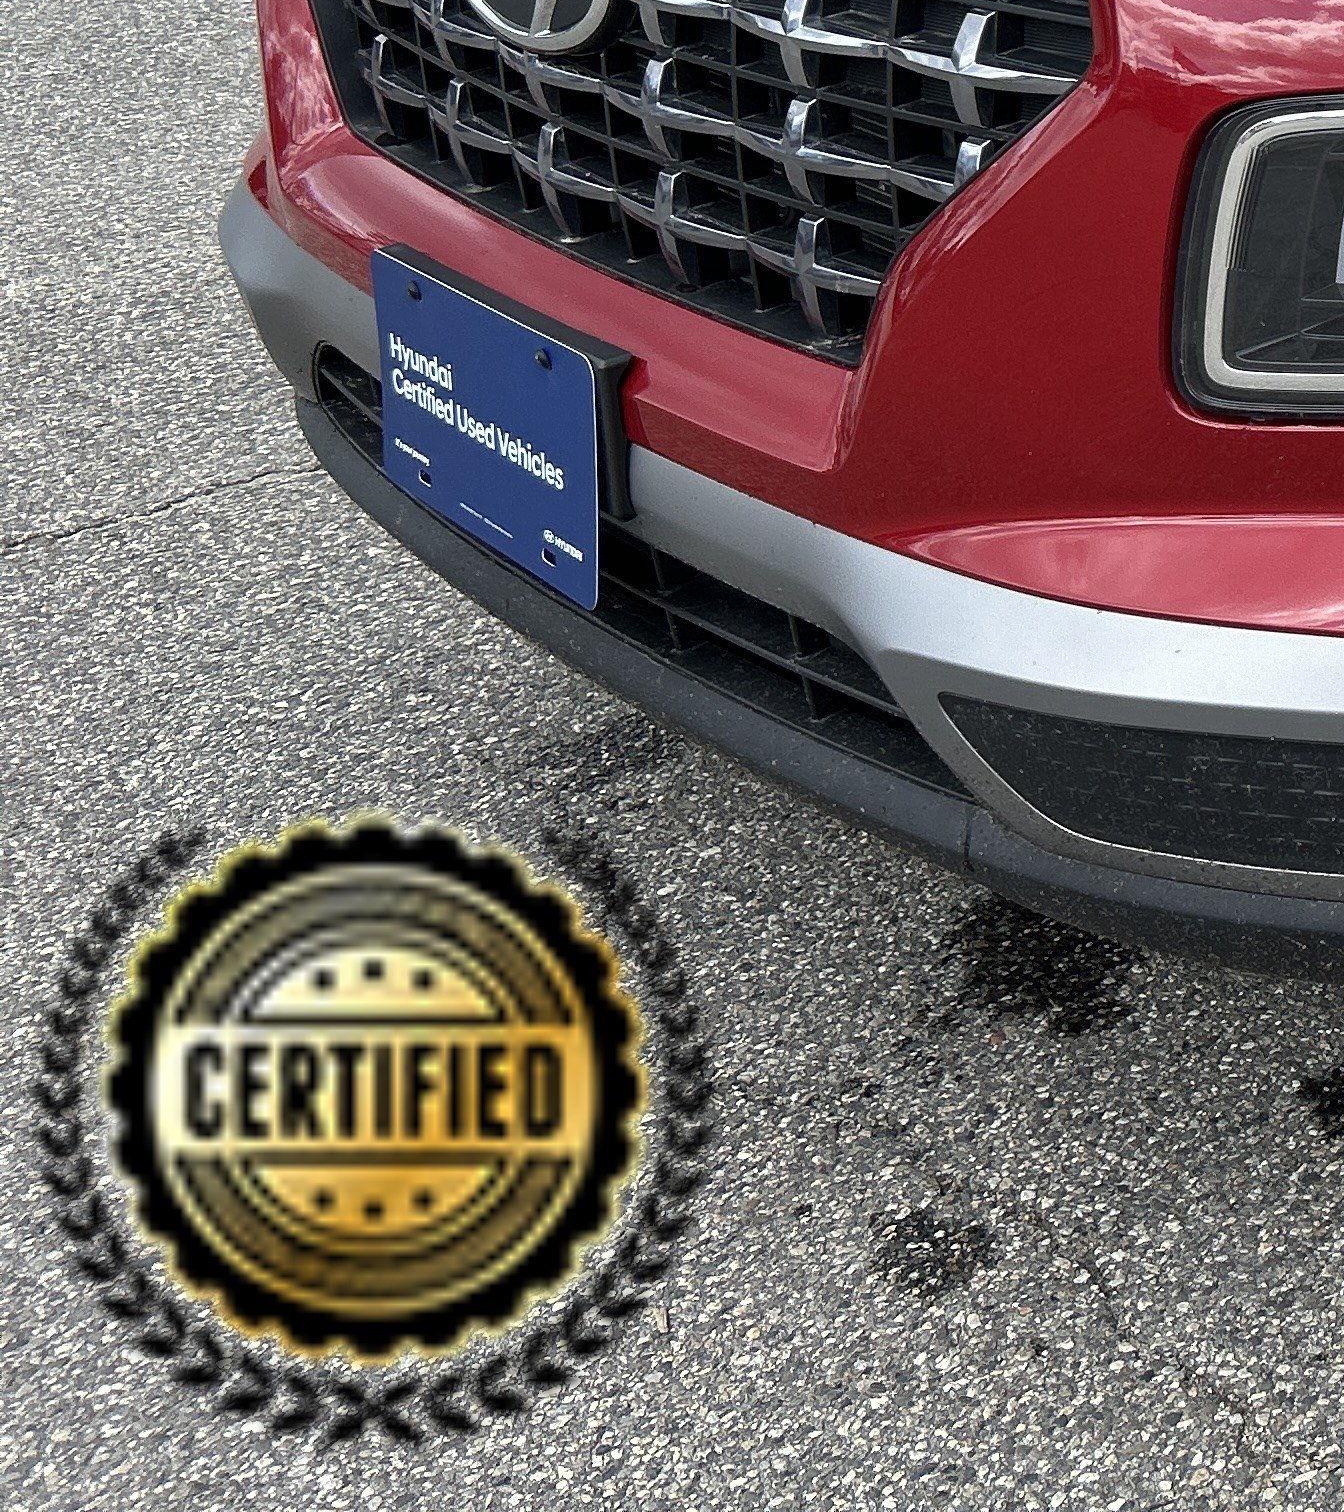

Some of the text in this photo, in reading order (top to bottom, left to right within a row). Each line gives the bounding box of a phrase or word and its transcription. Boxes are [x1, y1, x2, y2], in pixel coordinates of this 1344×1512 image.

[389, 332, 454, 392] Hyundai
[392, 367, 455, 427] Certified
[455, 403, 497, 451] Used
[496, 426, 565, 491] Vehicles
